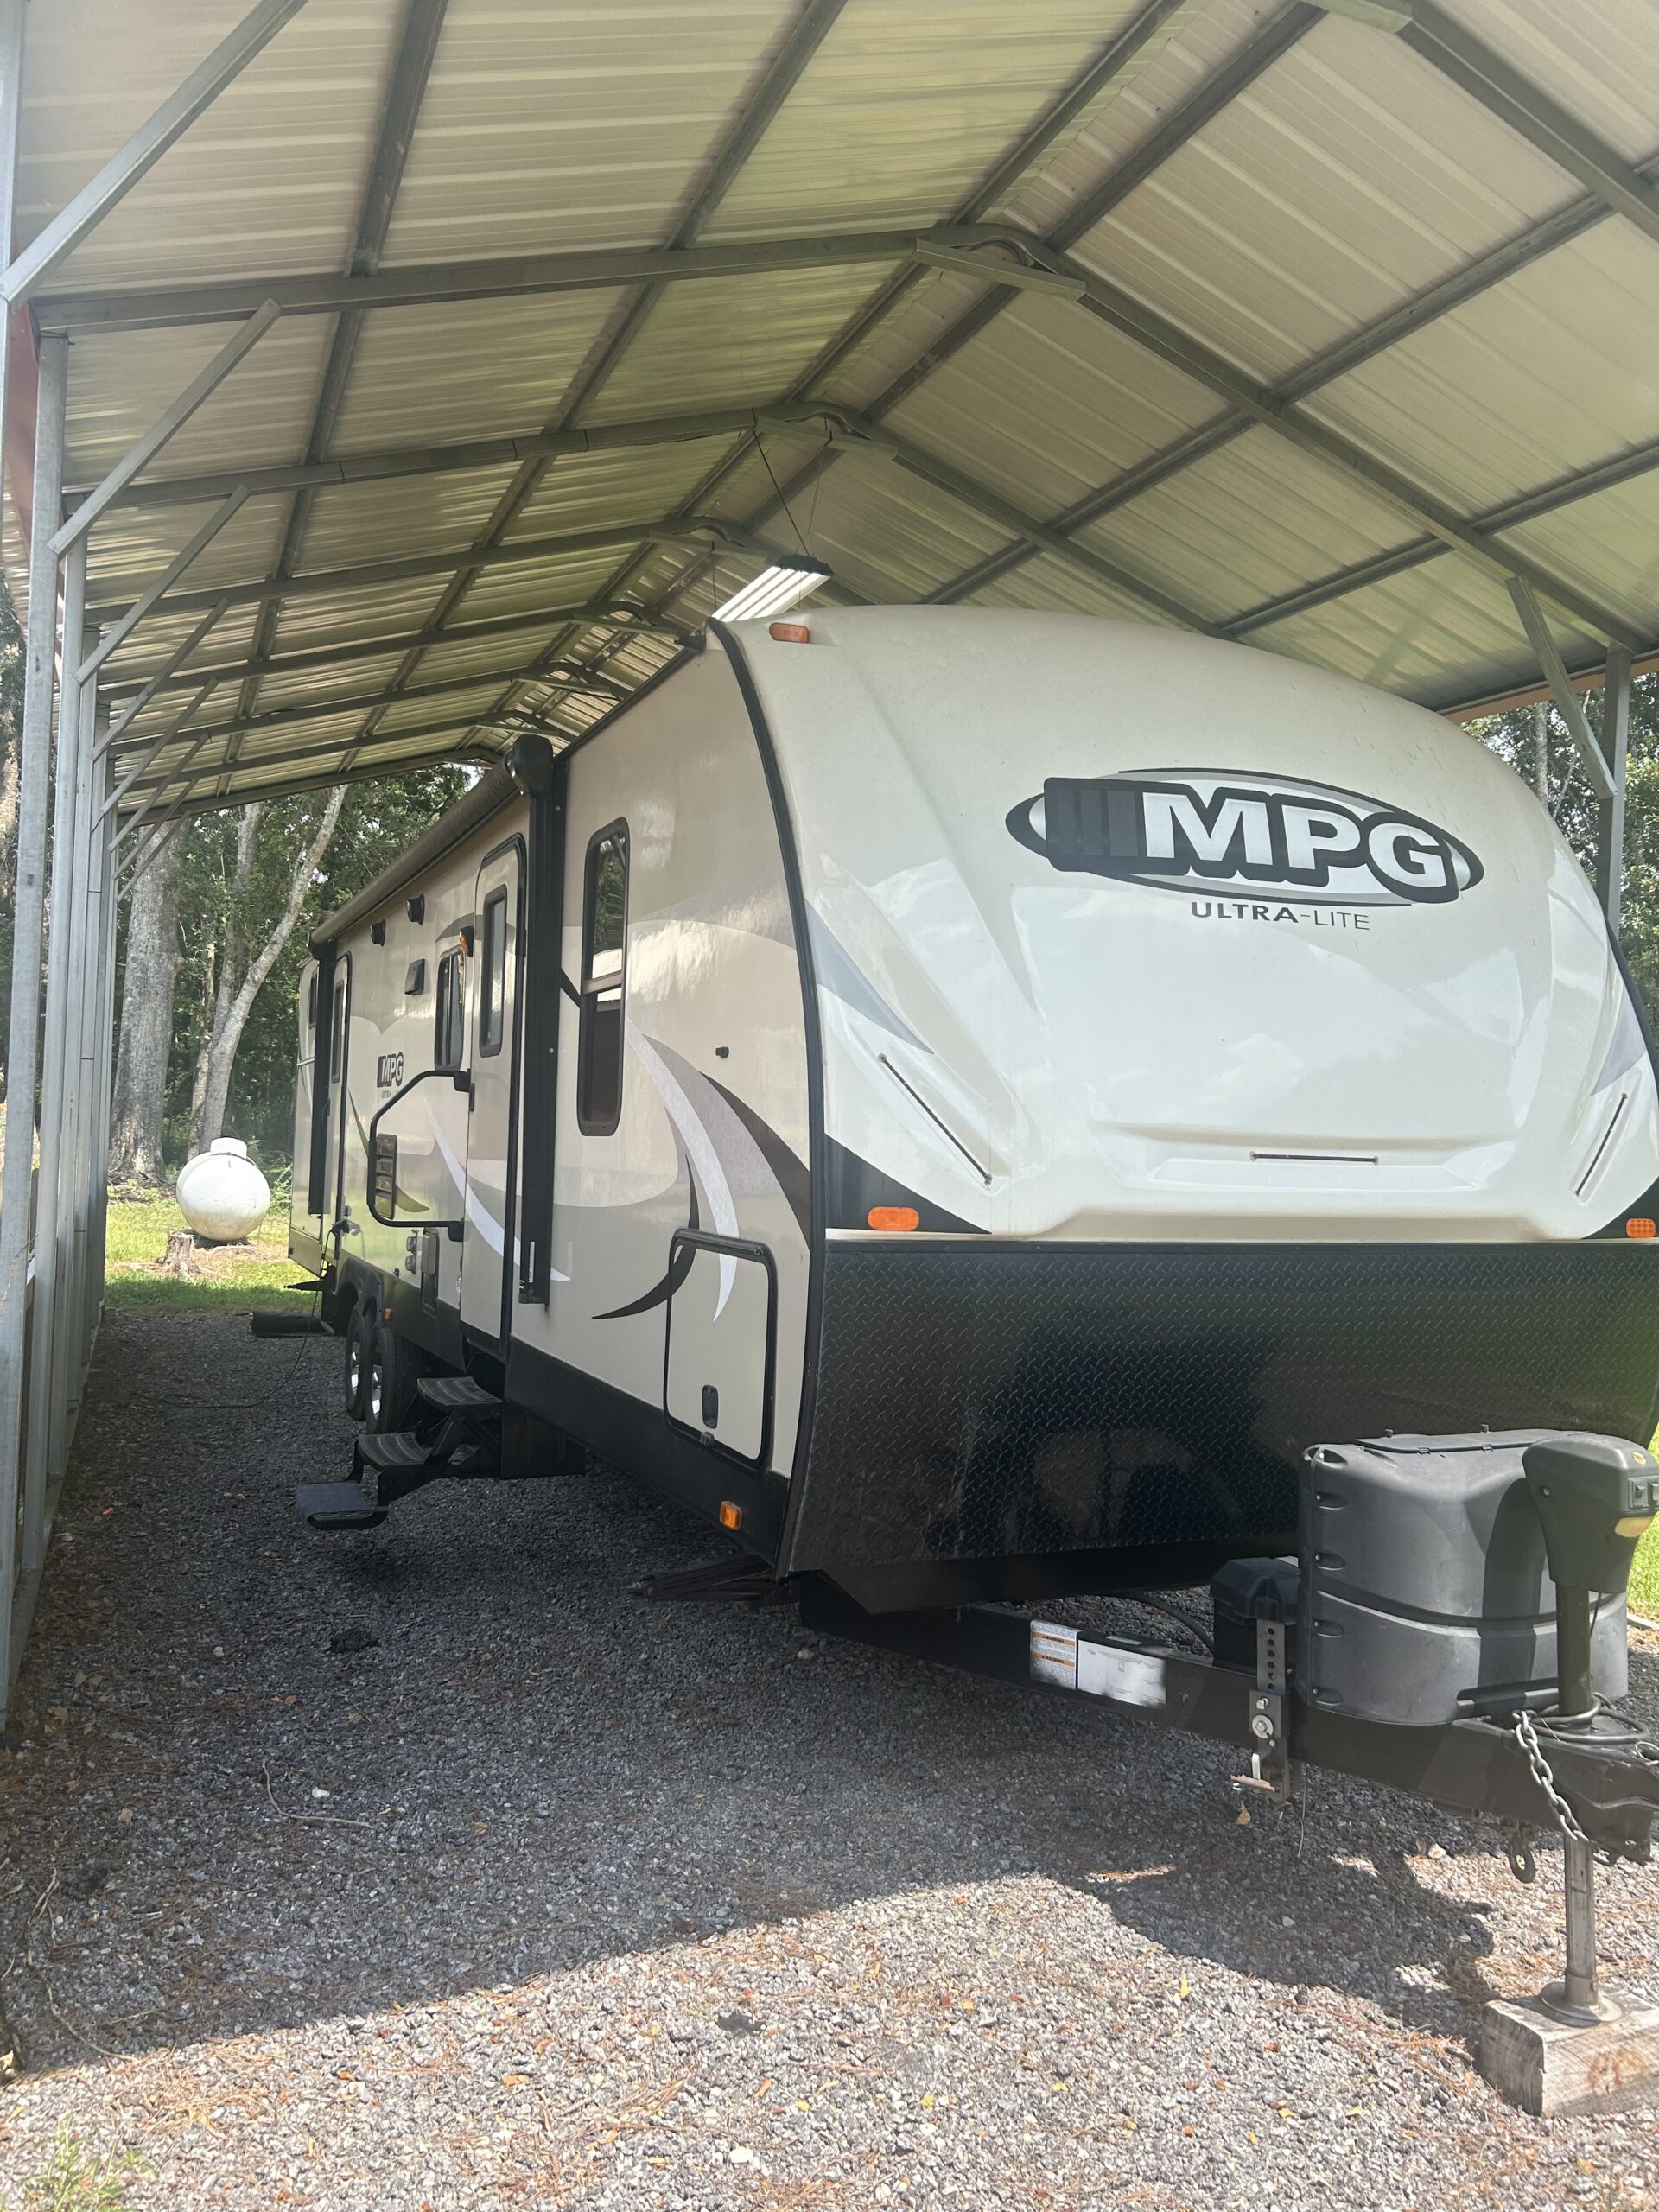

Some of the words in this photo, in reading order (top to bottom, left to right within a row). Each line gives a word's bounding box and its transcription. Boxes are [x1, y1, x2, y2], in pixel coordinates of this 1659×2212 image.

[1142, 791, 1448, 888] MPG
[1191, 901, 1370, 931] ULTRA-LITE
[380, 1053, 404, 1084] MPG
